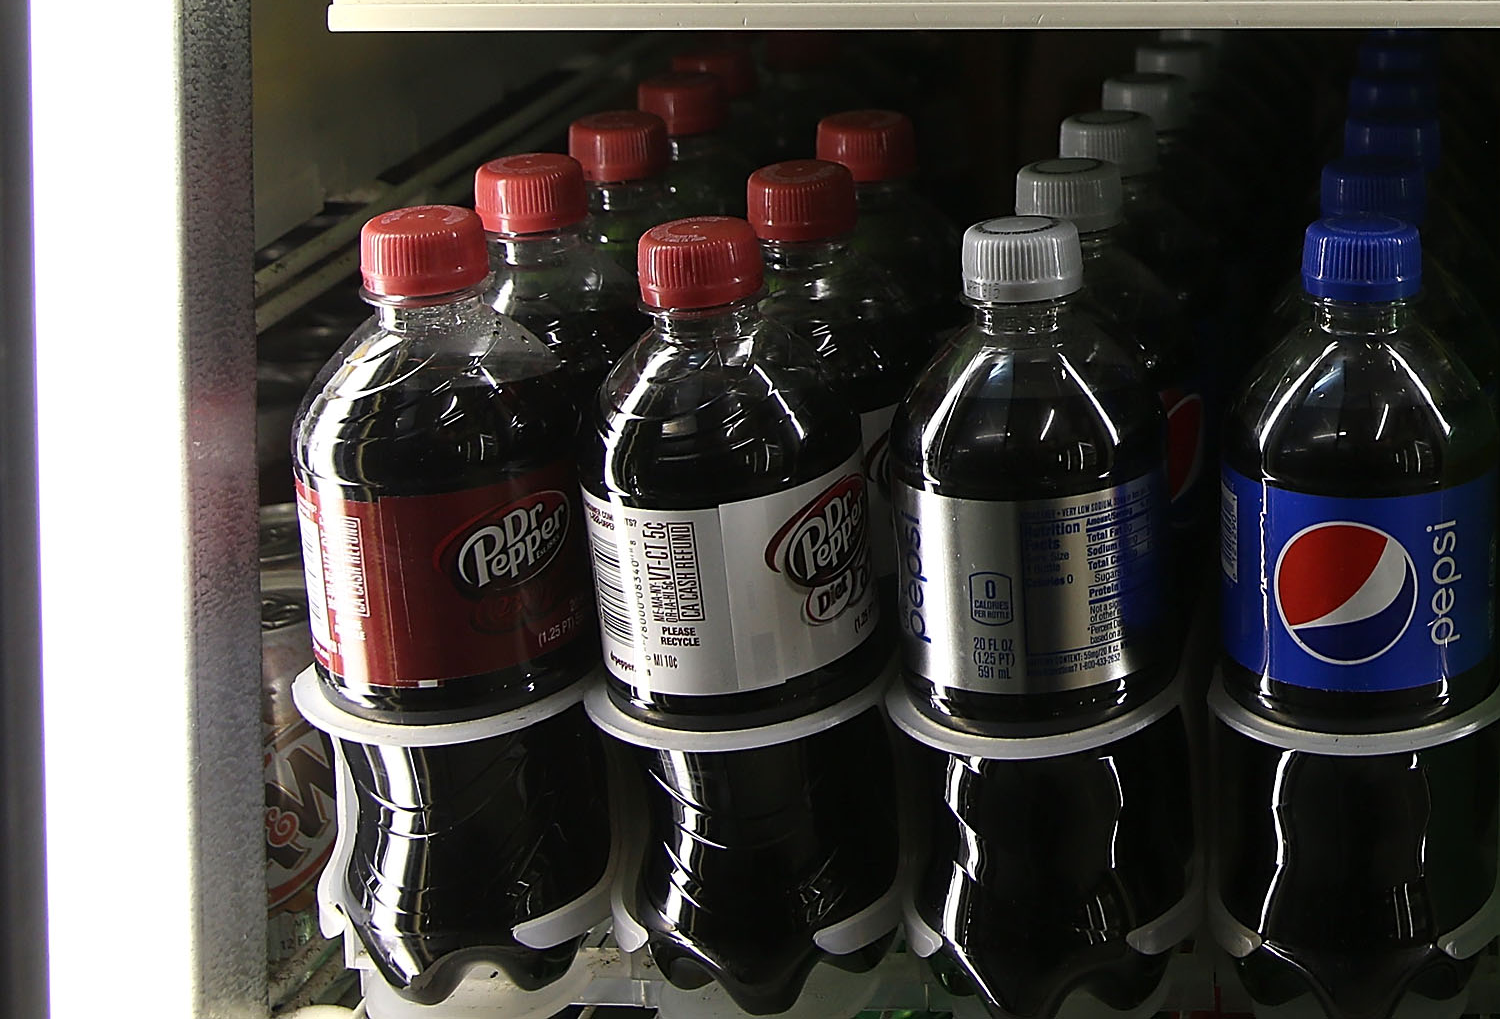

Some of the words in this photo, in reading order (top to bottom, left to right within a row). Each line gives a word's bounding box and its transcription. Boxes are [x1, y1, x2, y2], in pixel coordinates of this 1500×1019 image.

[824, 489, 852, 538] Dr
[1062, 508, 1077, 517] VERY
[1077, 505, 1090, 514] LOW
[502, 502, 544, 548] Dr
[642, 522, 666, 540] 5¢
[789, 490, 865, 581] Pepper
[1087, 532, 1108, 543] Total
[458, 503, 566, 588] Pepper
[670, 526, 695, 568] REFUND
[1087, 542, 1118, 557] Sodium
[644, 542, 671, 580] VT-CT
[1088, 557, 1110, 570] Total
[676, 572, 698, 601] CASH
[900, 510, 933, 645] pepsi
[1426, 520, 1462, 647] pepsi
[818, 573, 849, 617] Diet
[984, 580, 996, 600] 0
[1088, 582, 1120, 598] Protein
[680, 604, 701, 618] CA
[974, 598, 1010, 611] CALORIES
[974, 609, 986, 620] PER
[538, 624, 560, 649] (1.25
[662, 626, 696, 636] PLEASE
[660, 636, 700, 647] RECYCLE
[973, 636, 986, 652] 20
[988, 638, 1000, 652] FL
[1000, 638, 1013, 652] OZ
[653, 653, 664, 666] MI
[973, 650, 997, 667] (1.25
[998, 652, 1016, 668] PT)
[978, 664, 995, 679] 591
[998, 666, 1012, 680] mL
